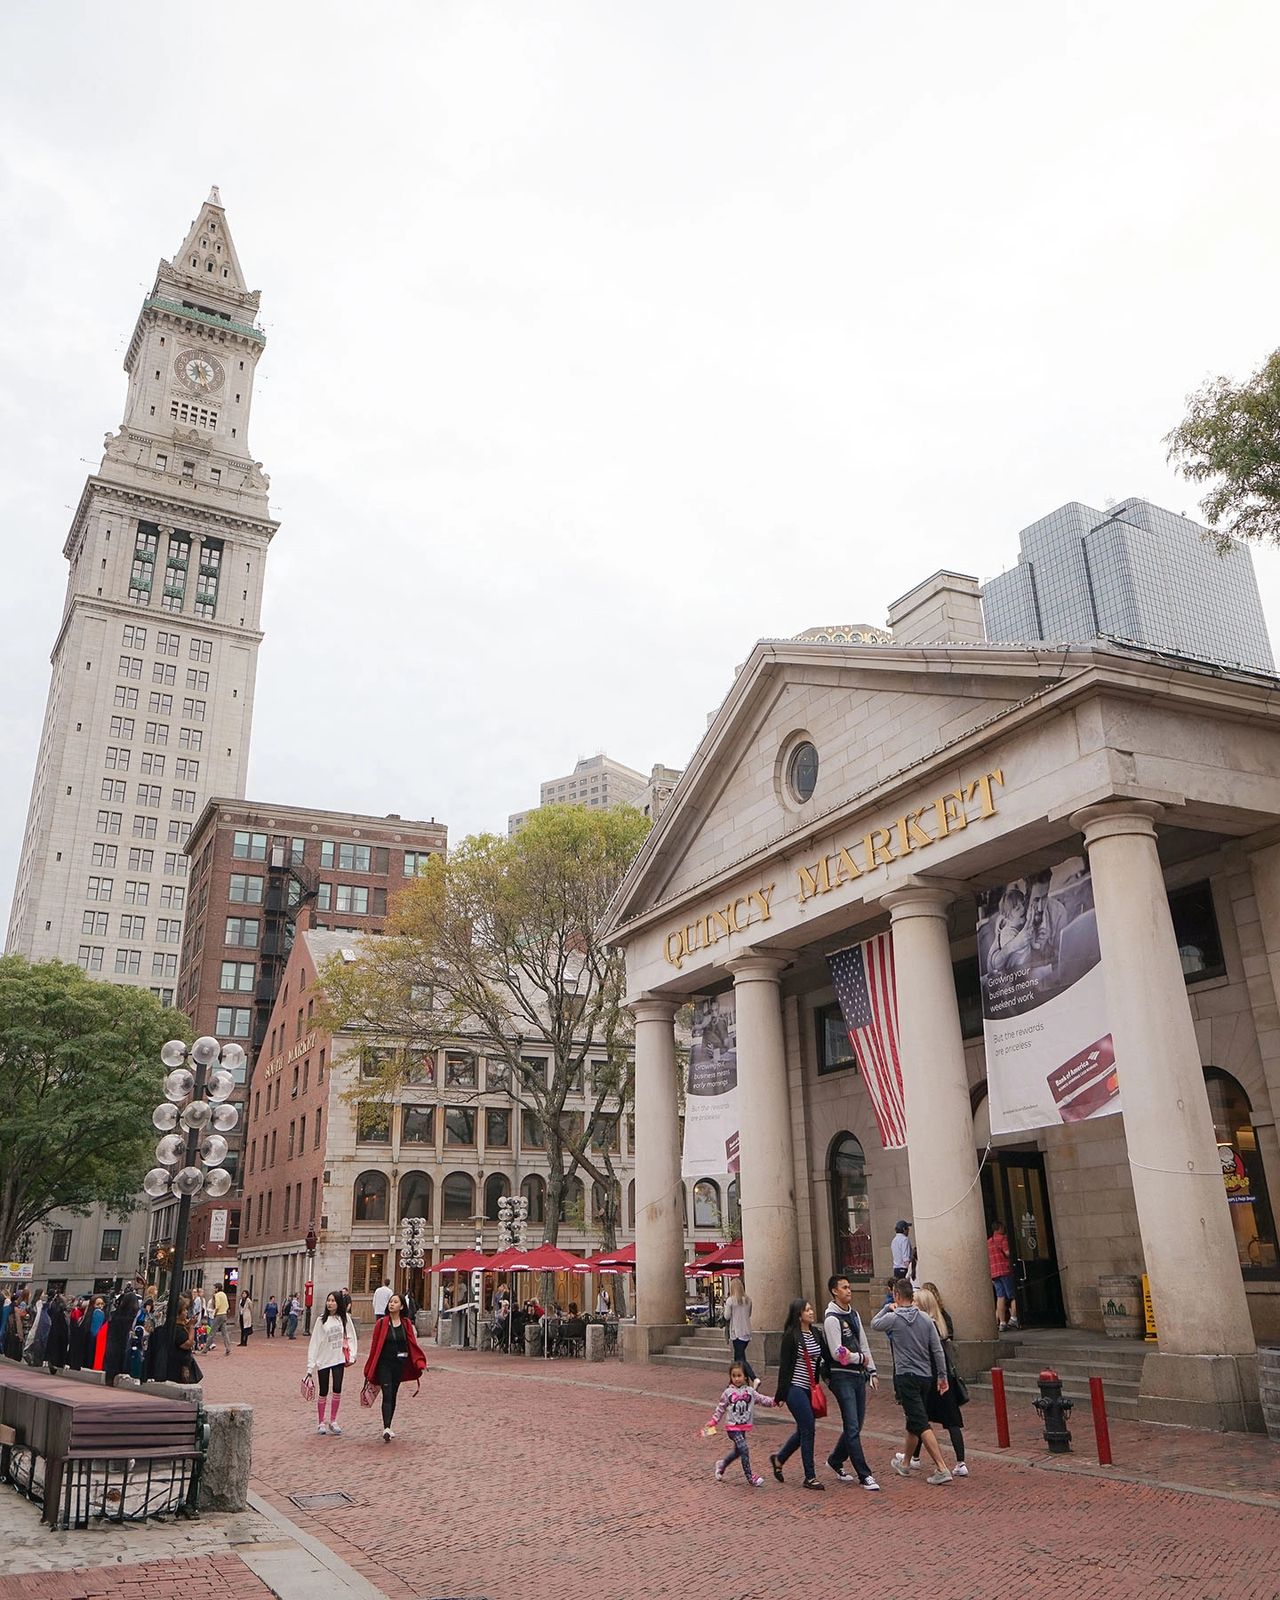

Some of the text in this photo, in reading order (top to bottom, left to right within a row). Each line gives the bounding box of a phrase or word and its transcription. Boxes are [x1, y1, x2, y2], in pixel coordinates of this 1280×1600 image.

[663, 768, 1005, 969] QUINCY MARKET
[988, 967, 1031, 988] Growing your
[989, 978, 1039, 1000] business means
[990, 992, 1034, 1013] weekend work
[1004, 1031, 1015, 1040] the
[1016, 1022, 1044, 1038] rewards
[1004, 1040, 1032, 1055] priceless
[1055, 1075, 1068, 1087] Bank
[1070, 1060, 1090, 1076] America
